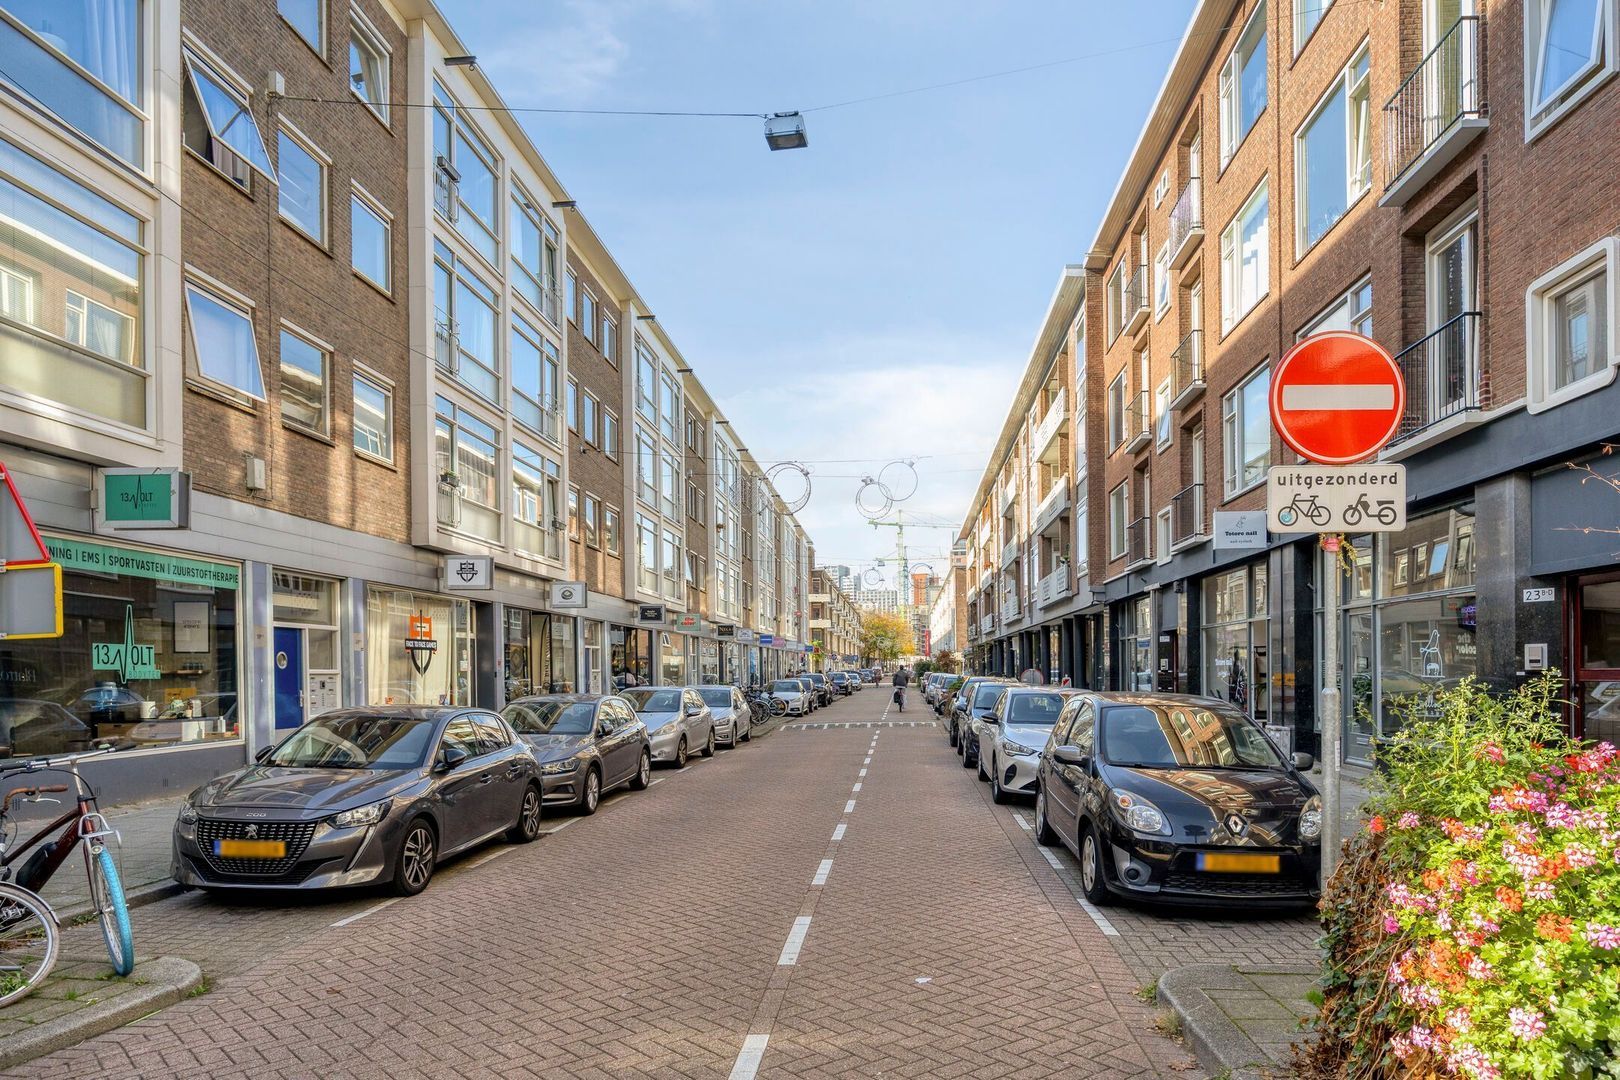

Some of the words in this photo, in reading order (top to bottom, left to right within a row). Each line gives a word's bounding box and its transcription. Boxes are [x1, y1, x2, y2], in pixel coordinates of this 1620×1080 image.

[1277, 472, 1398, 489] uitgezonderd
[81, 551, 100, 564] EMS
[108, 555, 166, 575] SPORTVASTEN
[172, 565, 239, 584] ZUURSTOFTHERAPIE
